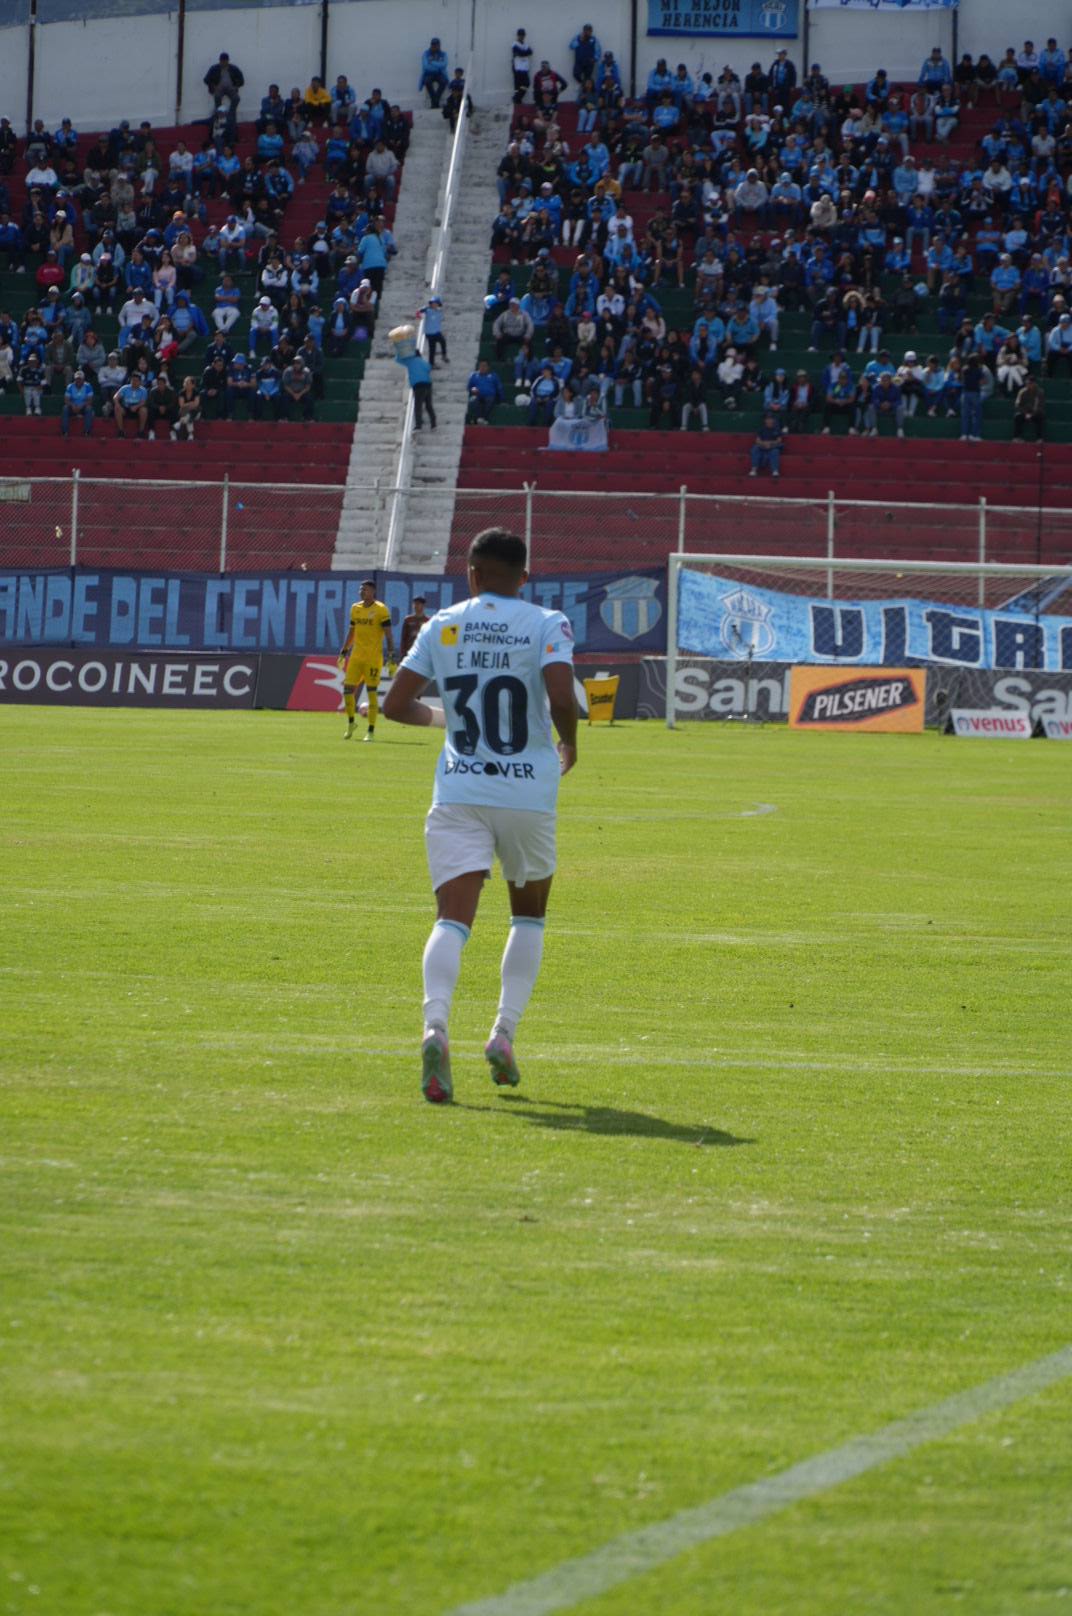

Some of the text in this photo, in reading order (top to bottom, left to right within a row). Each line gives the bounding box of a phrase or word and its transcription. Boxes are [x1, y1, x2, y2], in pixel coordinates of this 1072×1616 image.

[662, 13, 738, 27] HERENCIA
[691, 0, 740, 12] MEJOR
[108, 576, 190, 646] DEL
[463, 633, 531, 646] PICHINCHA
[465, 622, 508, 632] BANCO
[810, 604, 1072, 669] ULTR
[457, 652, 510, 668] E. MEJIA
[674, 667, 790, 713] San
[813, 682, 903, 719] PILSENER
[993, 676, 1072, 722] Sa
[444, 674, 529, 757] 30
[445, 759, 536, 780] DISCOVER
